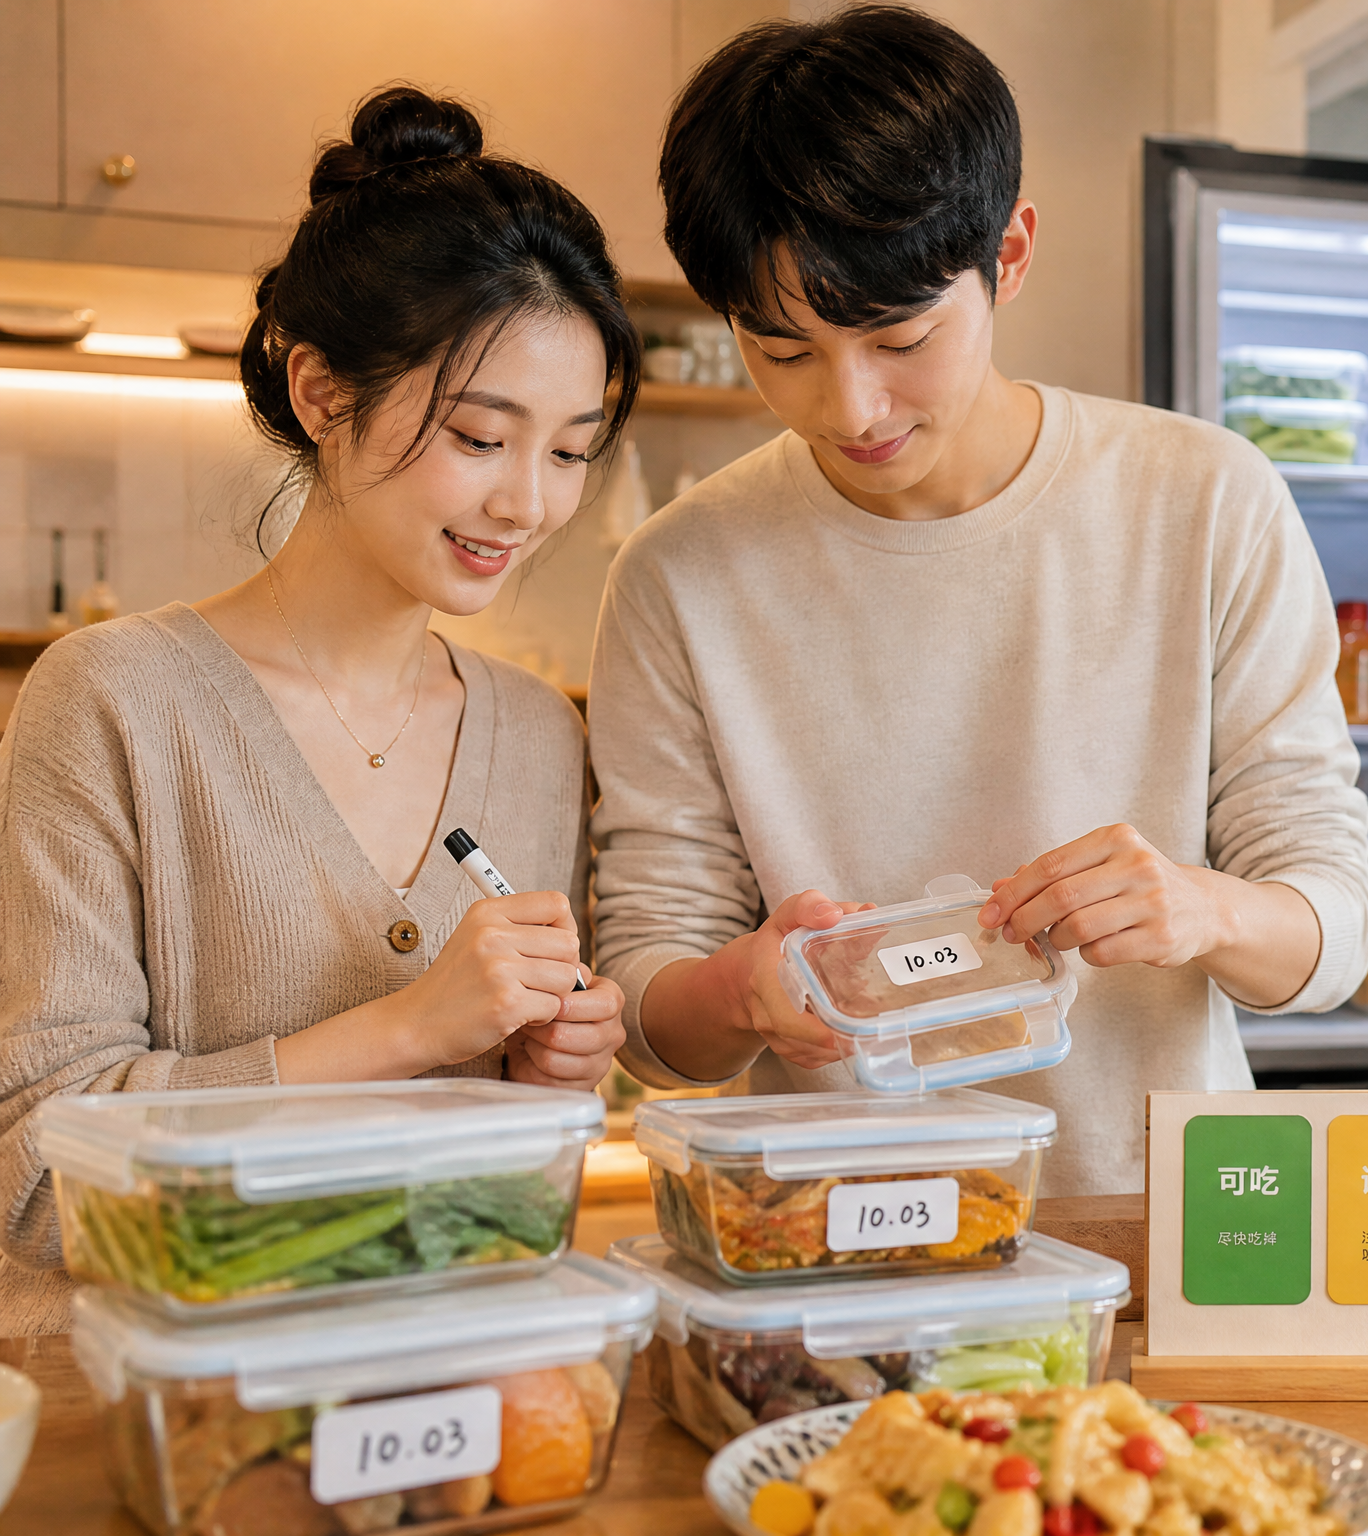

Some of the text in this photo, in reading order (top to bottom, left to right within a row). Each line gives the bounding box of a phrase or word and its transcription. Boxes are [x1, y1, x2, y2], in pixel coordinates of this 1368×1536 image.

[904, 946, 958, 973] 10.03
[1217, 1164, 1280, 1196] 可吃
[858, 1201, 930, 1234] 10.03
[358, 1418, 467, 1473] 10.03
